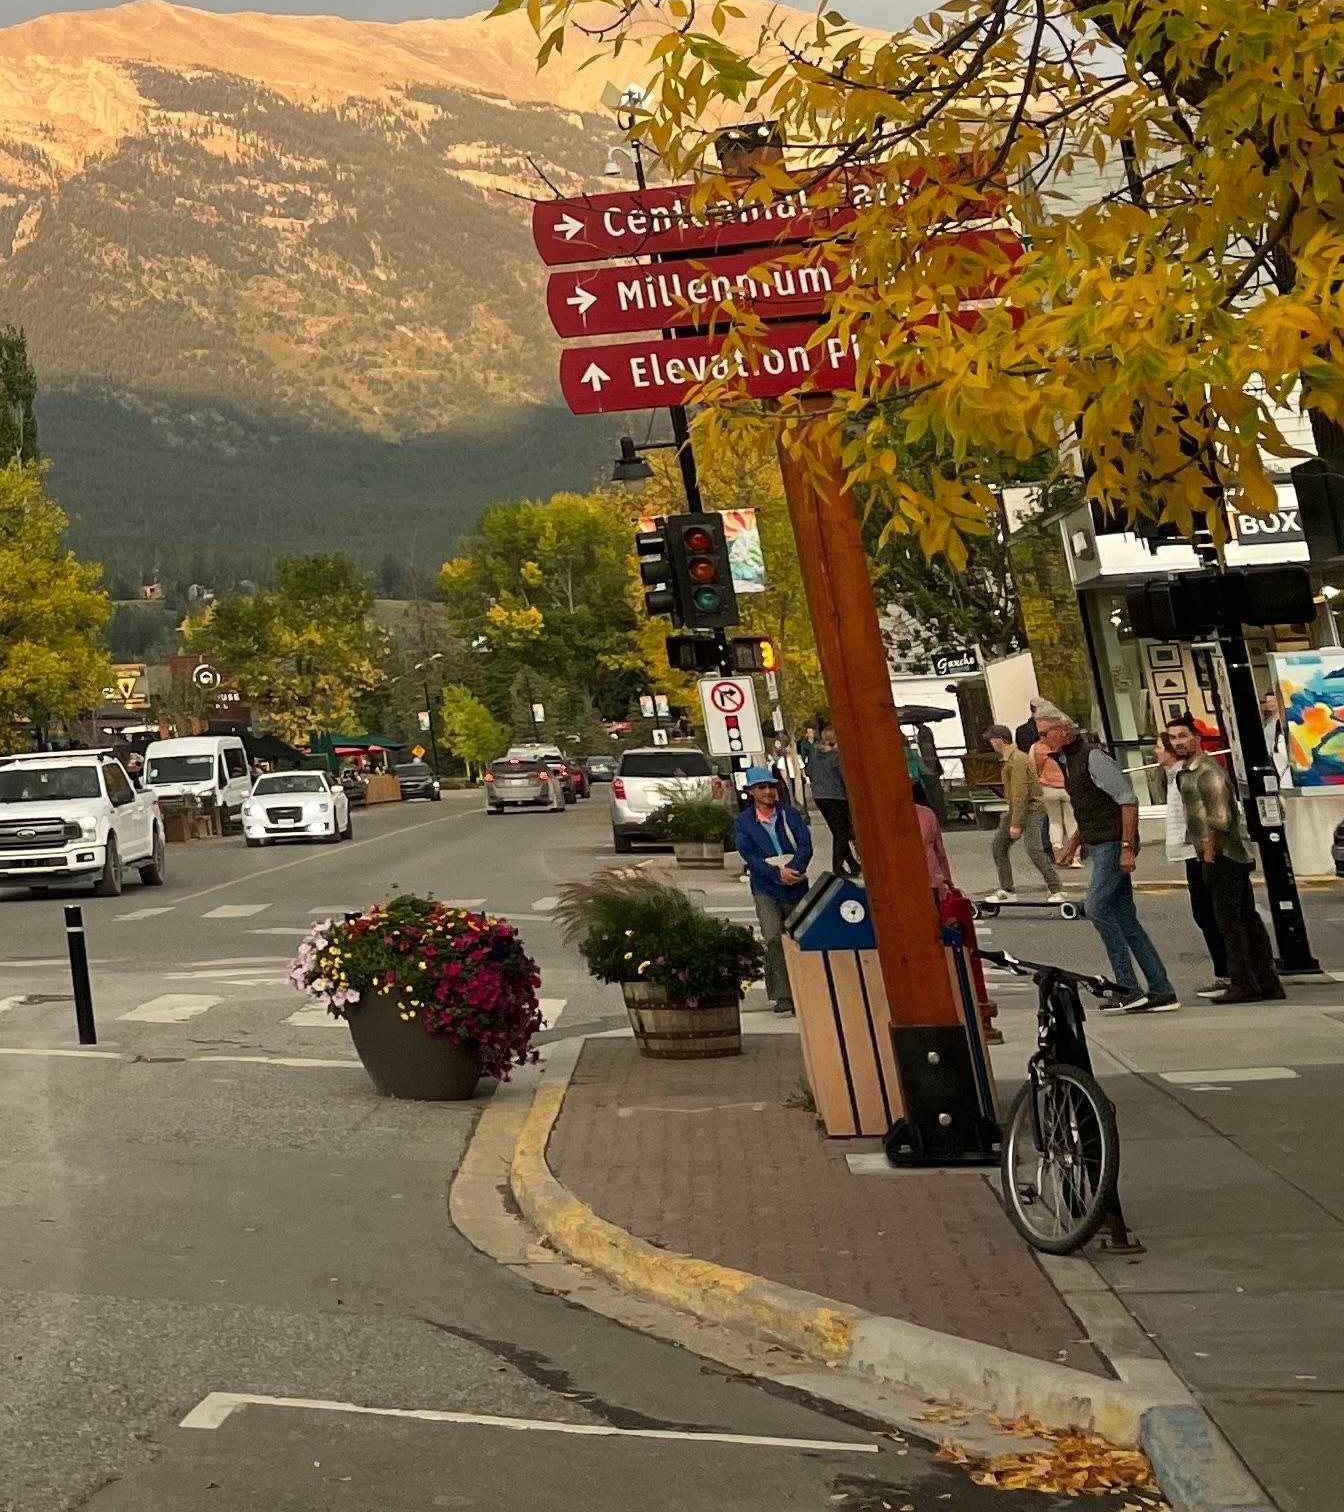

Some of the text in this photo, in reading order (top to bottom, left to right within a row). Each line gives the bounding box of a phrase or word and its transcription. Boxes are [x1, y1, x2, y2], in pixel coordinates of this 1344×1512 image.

[617, 267, 832, 311] Millennium
[630, 346, 810, 387] Elevaton
[1240, 510, 1301, 536] BOX
